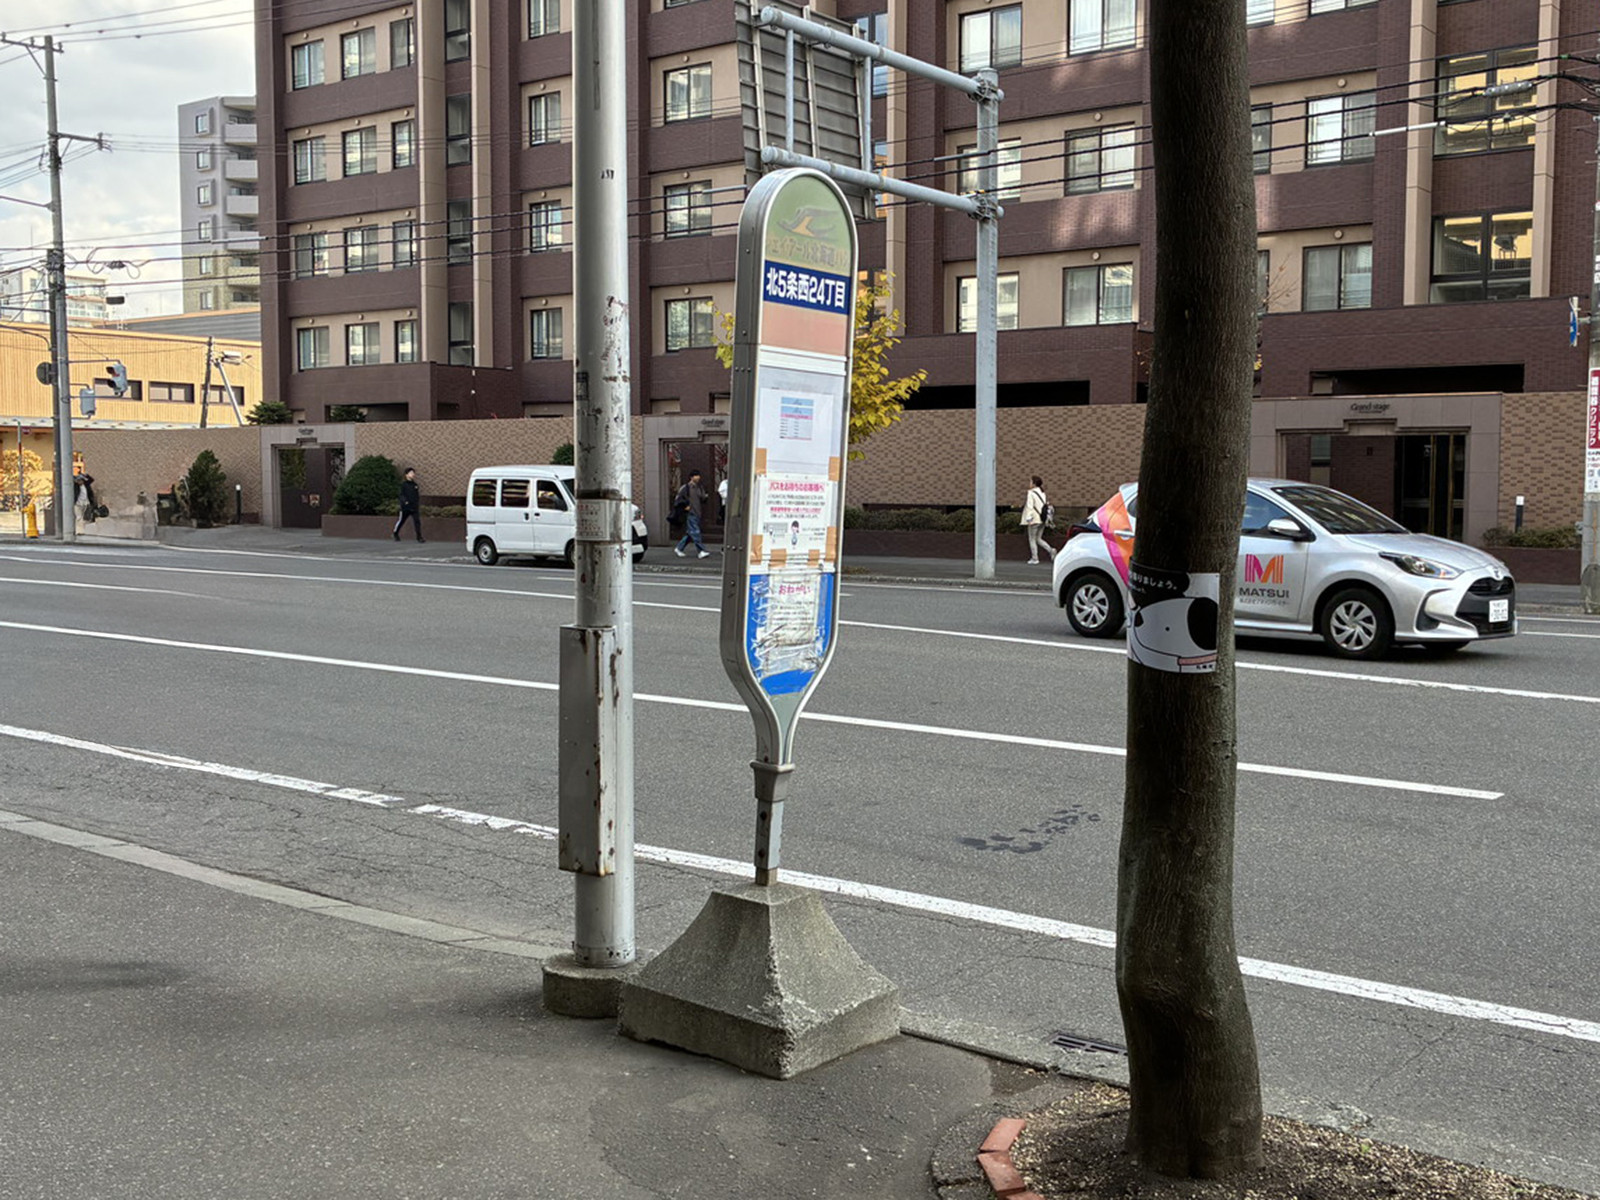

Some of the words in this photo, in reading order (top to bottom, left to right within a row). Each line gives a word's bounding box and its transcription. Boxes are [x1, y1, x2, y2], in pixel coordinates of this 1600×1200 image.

[767, 267, 845, 308] 北5条西24丁目
[1239, 587, 1290, 598] MATSUI
